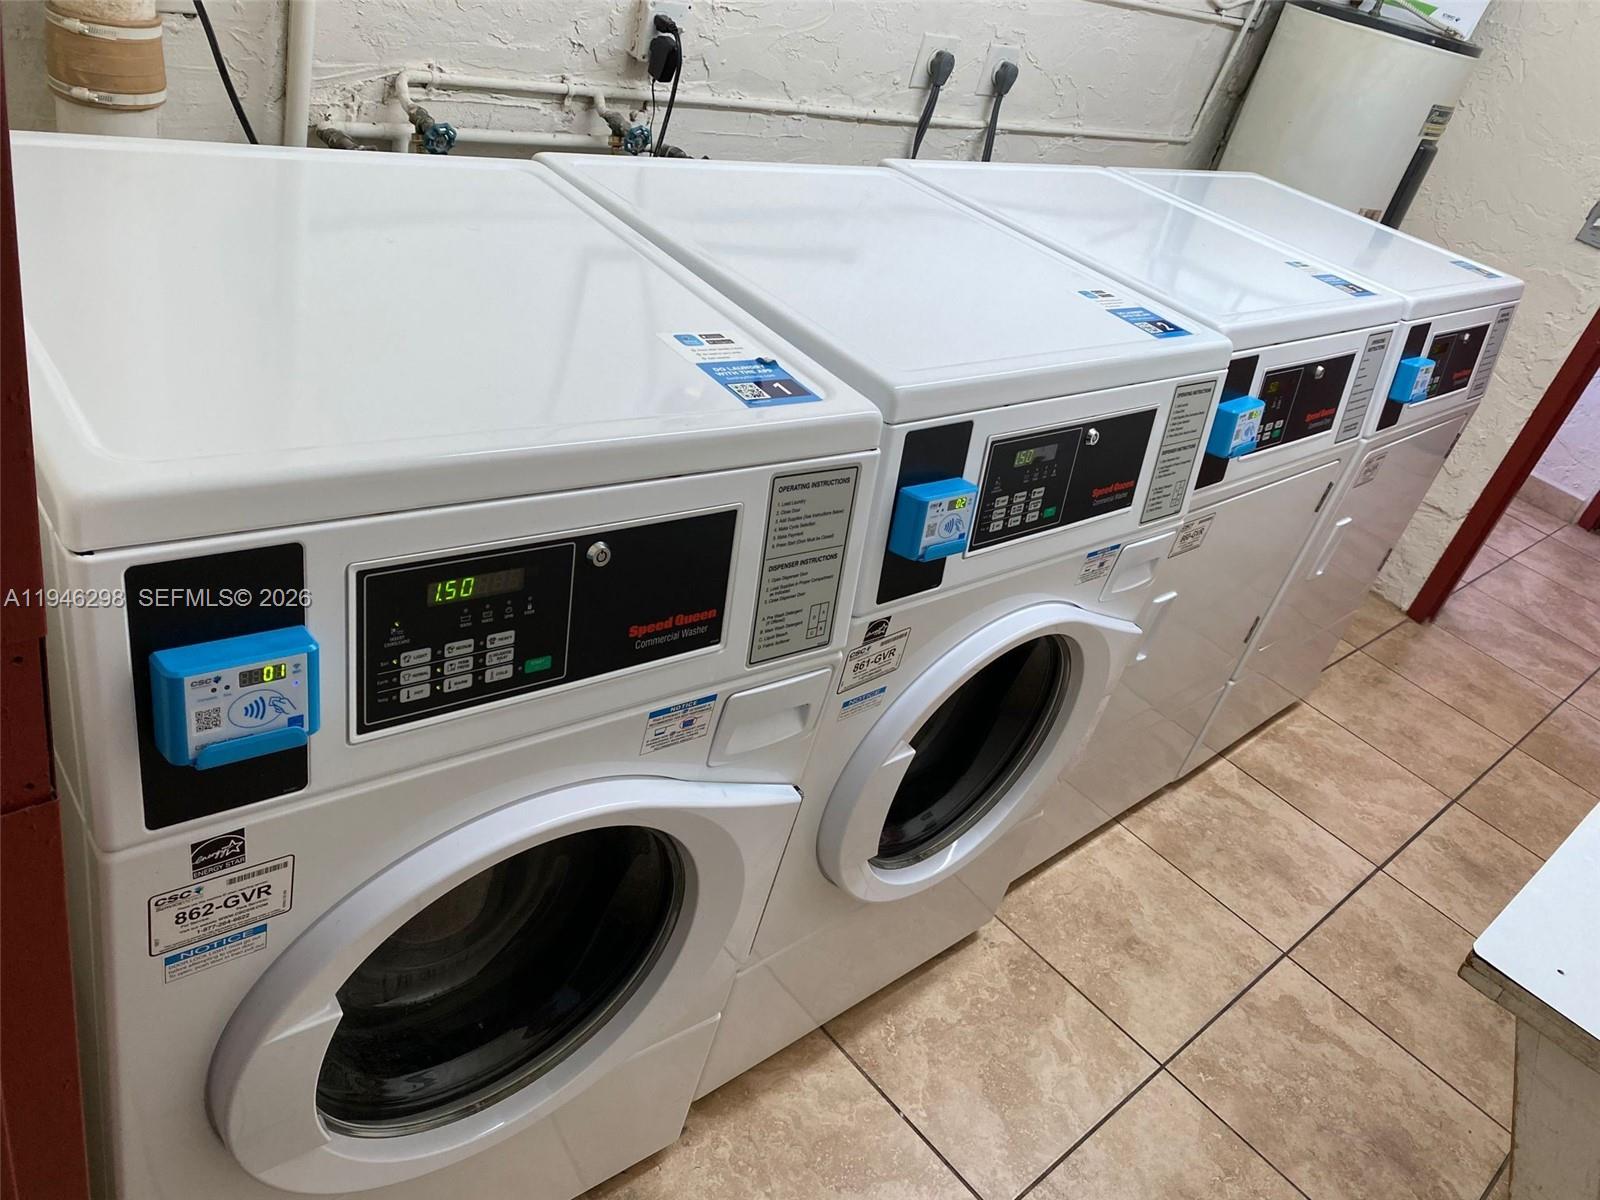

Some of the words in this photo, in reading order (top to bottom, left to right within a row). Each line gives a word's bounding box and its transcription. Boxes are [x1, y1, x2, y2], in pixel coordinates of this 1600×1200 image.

[1156, 322, 1174, 330] 2
[773, 382, 792, 395] 1
[778, 482, 810, 493] OPERATING
[812, 477, 850, 488] INSTRUCTIONS
[768, 561, 799, 572] DISPENSER
[800, 553, 838, 566] INSTRUCTIONS
[629, 616, 673, 638] Speed
[674, 608, 718, 626] Queen
[635, 632, 680, 649] Commercial
[682, 625, 708, 638] Washer
[853, 648, 896, 673] 861-GVR
[262, 664, 287, 682] 01
[190, 678, 212, 689] CSC
[671, 701, 697, 712] NOTICE
[193, 863, 224, 879] ENERGY
[225, 857, 246, 868] STAR
[154, 890, 192, 907] CSC
[174, 884, 272, 925] 862-GVR
[180, 929, 254, 960] NOTICE
